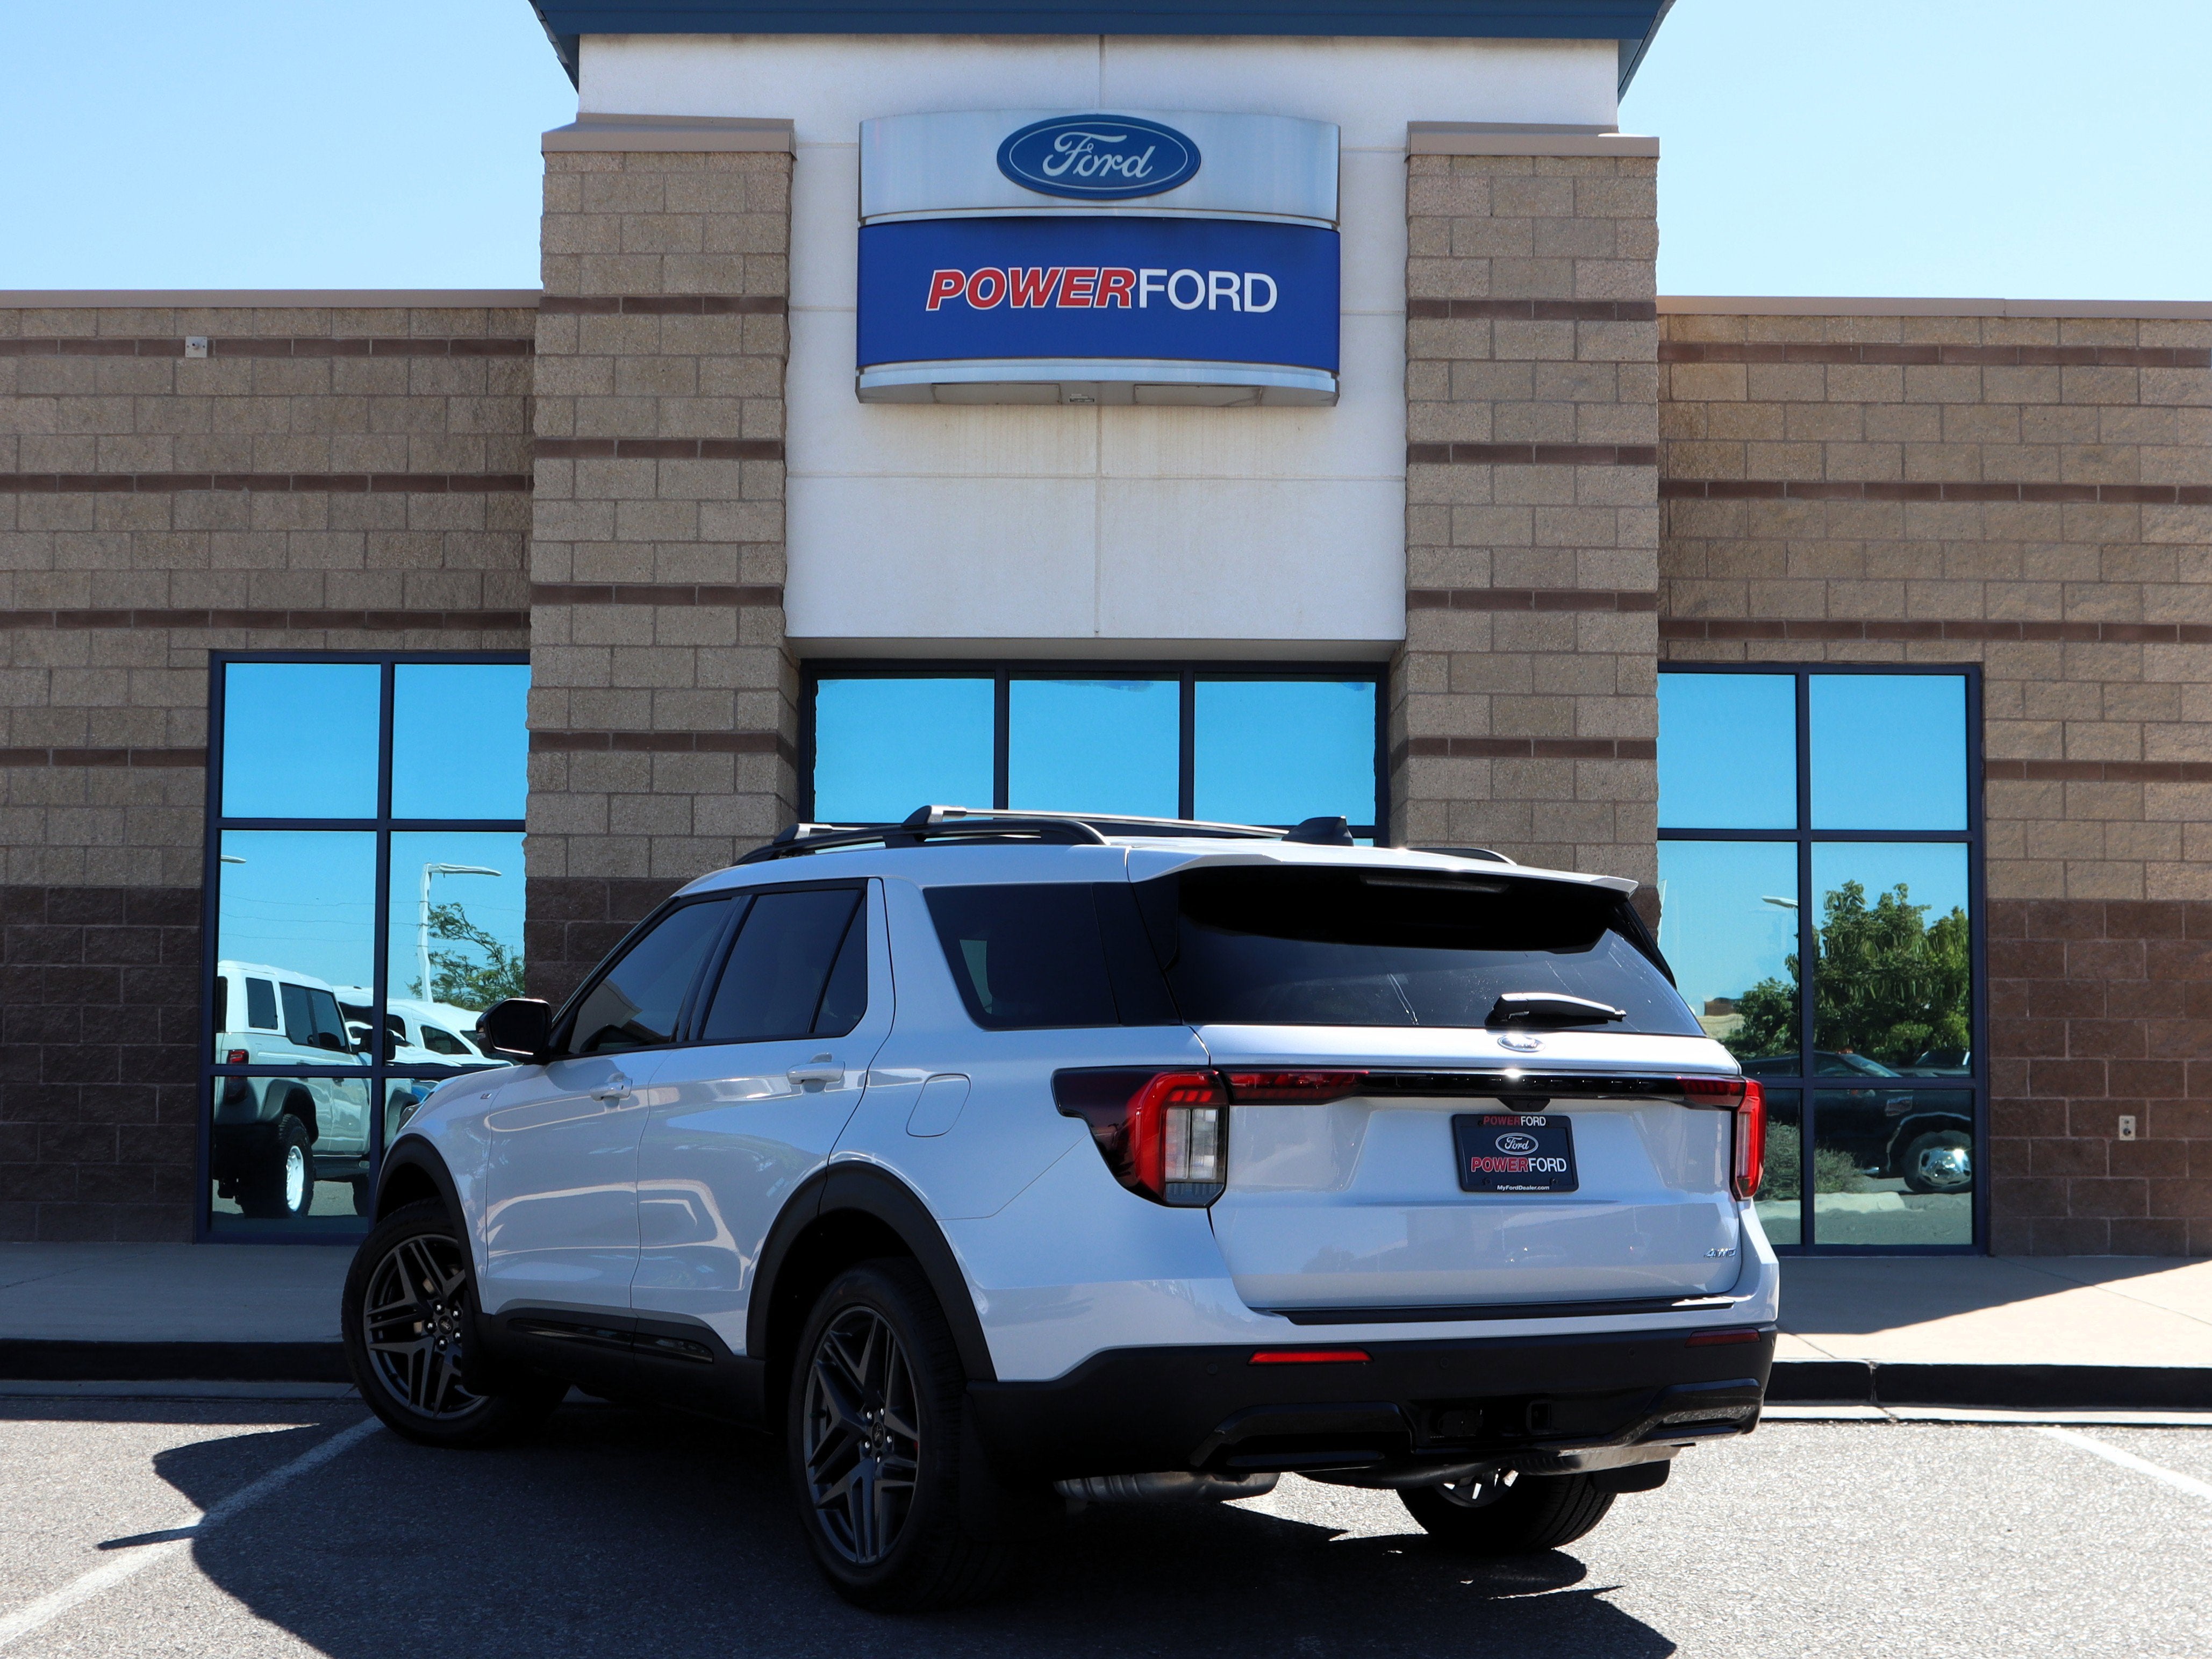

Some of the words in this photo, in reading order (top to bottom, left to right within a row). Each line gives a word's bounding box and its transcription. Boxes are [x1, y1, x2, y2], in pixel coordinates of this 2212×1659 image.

[1042, 132, 1156, 178] Ford
[925, 267, 1277, 313] POWERFORD
[1483, 1116, 1546, 1126] POWERFORD
[1505, 1136, 1529, 1150] Ford
[1471, 1157, 1567, 1172] POWERFORD
